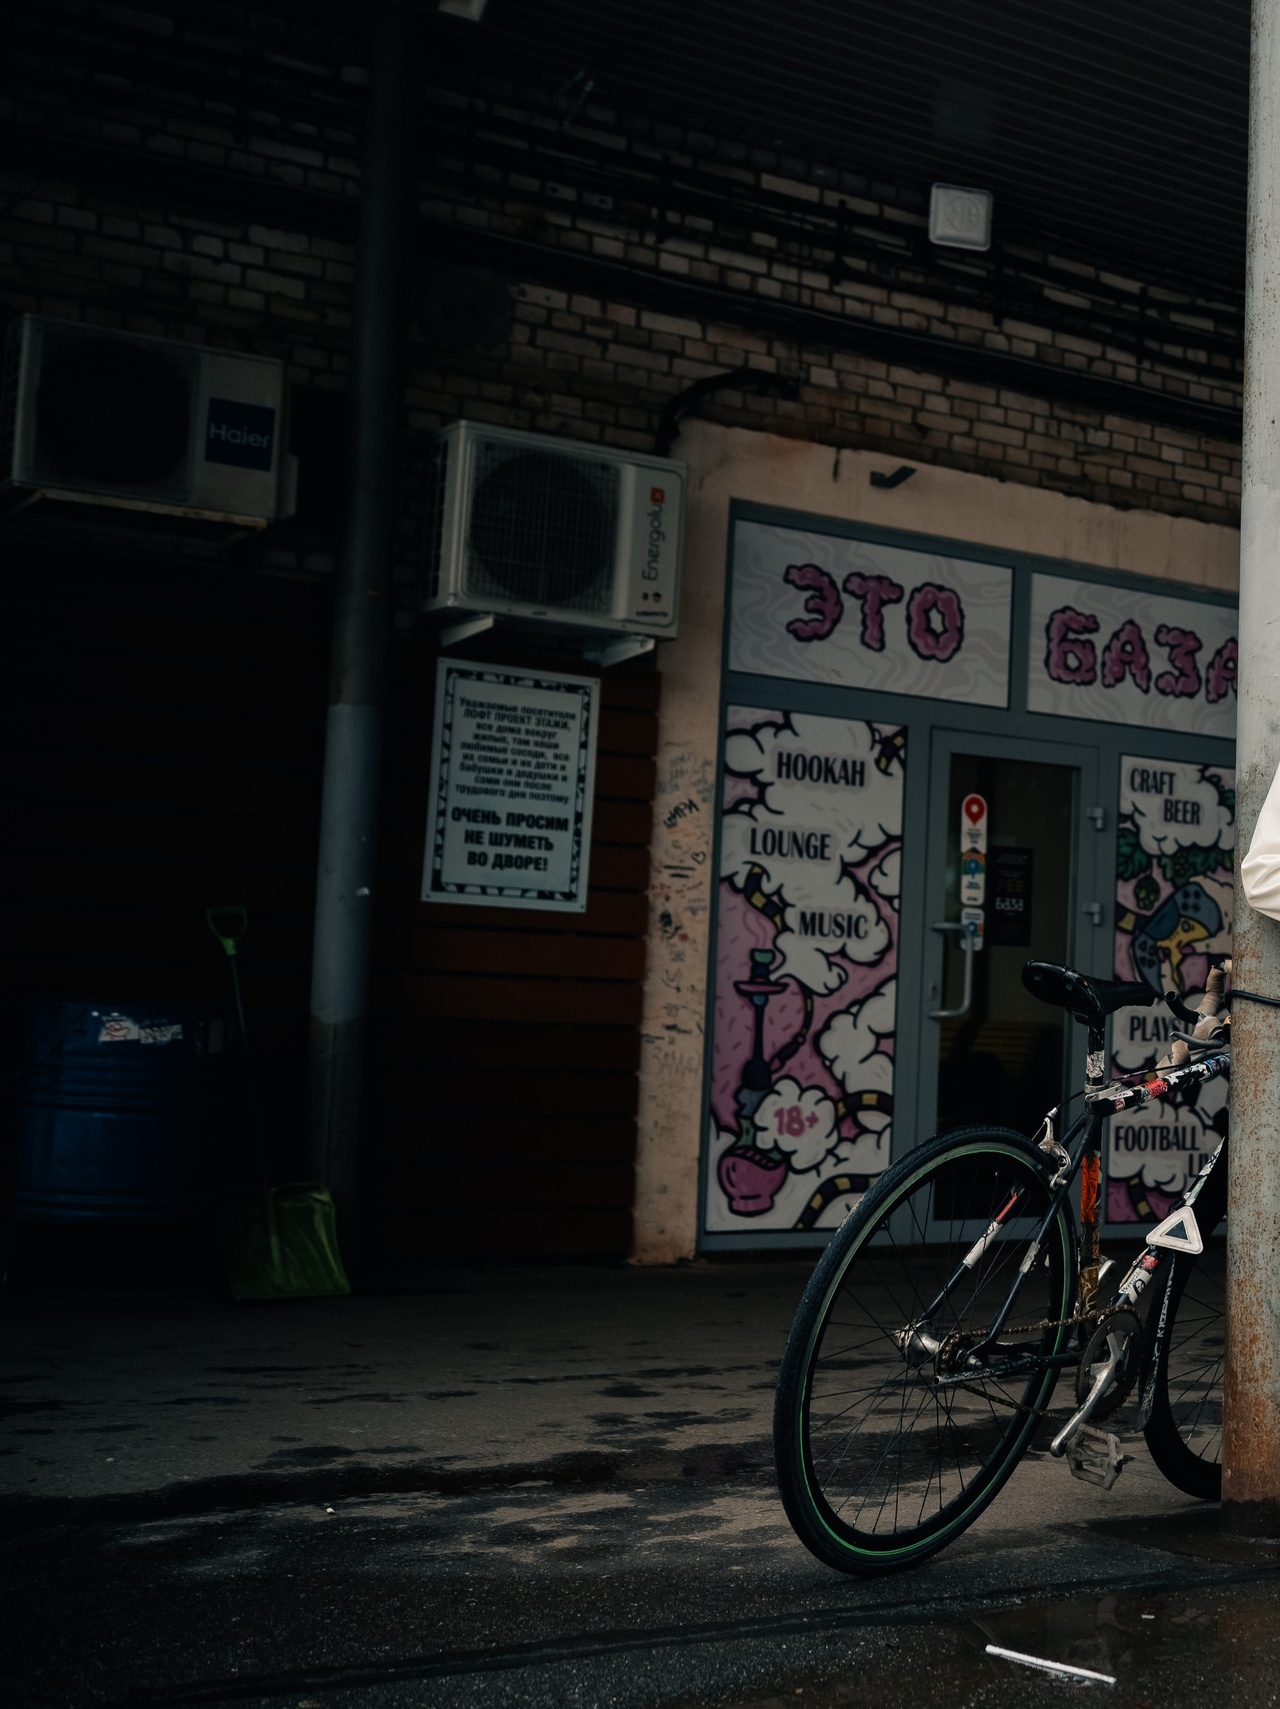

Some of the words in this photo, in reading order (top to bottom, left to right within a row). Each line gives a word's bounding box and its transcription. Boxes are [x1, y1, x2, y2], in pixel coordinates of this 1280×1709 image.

[208, 422, 271, 449] Haier
[783, 564, 965, 663] ЭТО
[1045, 605, 1238, 703] БАЗА
[777, 751, 865, 787] HOOKAH
[1131, 767, 1176, 796] CRAFT
[451, 807, 502, 826] ОЧЕНЬ
[506, 812, 569, 832] ПРОСИМ
[1164, 798, 1201, 825] BEER
[464, 829, 484, 845] НЕ
[488, 831, 554, 851] ШУМЕТЬ
[750, 828, 832, 861] LOUNGE
[467, 850, 488, 867] ВО
[491, 853, 549, 872] ДВОРЕ!
[799, 911, 868, 939] MUSIC
[774, 1106, 819, 1137] 18+
[1115, 1125, 1200, 1151] FOOTBALL
